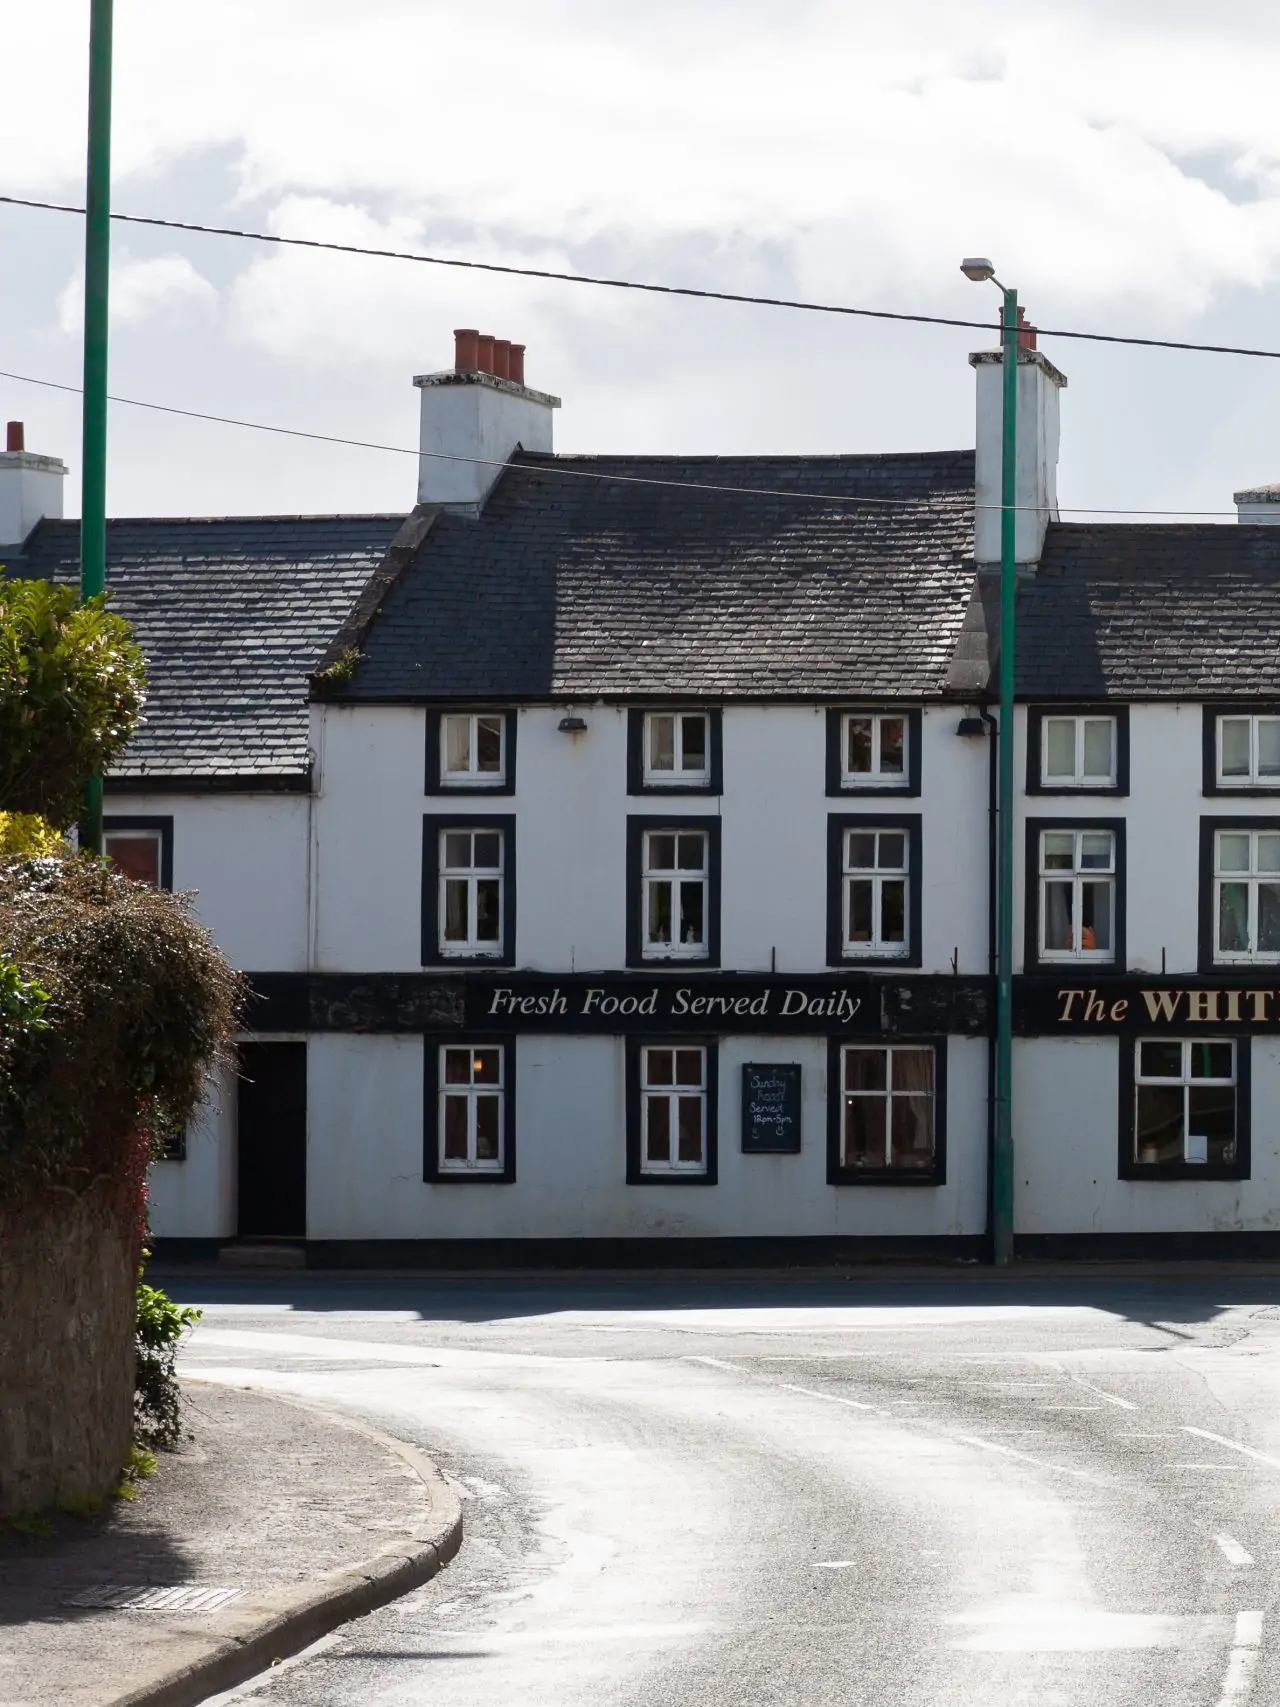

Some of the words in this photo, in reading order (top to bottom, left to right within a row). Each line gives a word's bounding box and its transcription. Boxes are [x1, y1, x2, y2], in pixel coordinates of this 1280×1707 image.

[488, 988, 568, 1014] Fresh
[580, 988, 659, 1014] Food
[671, 988, 771, 1015] Served
[779, 989, 861, 1023] Daily
[1057, 989, 1129, 1022] The
[750, 1075, 787, 1094] Sunday
[749, 1102, 783, 1113] Served
